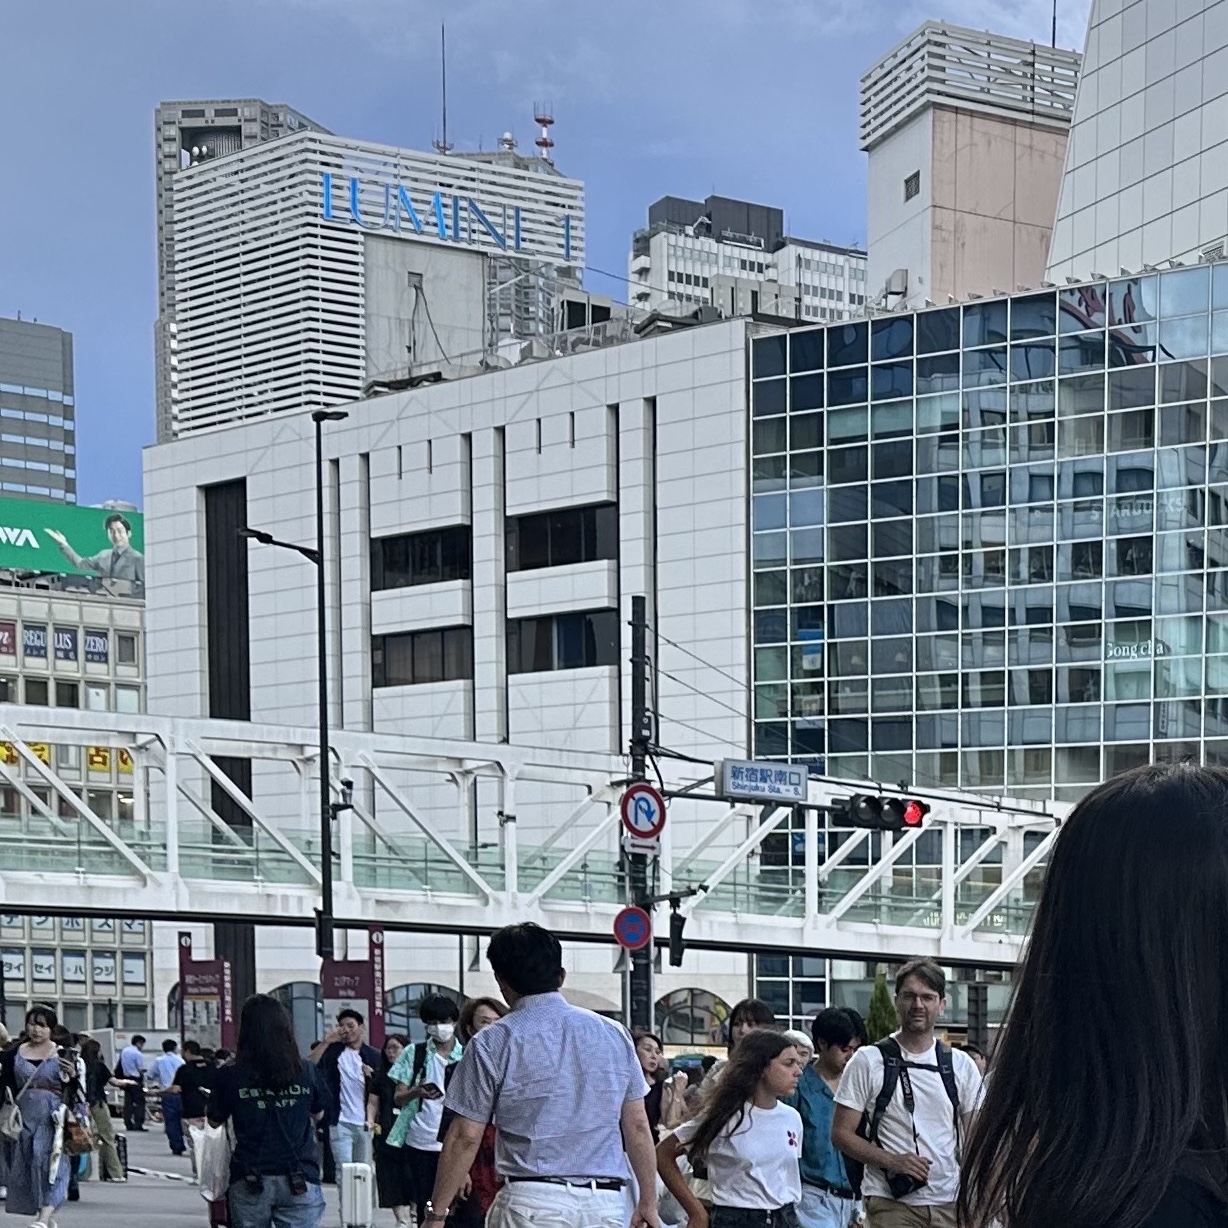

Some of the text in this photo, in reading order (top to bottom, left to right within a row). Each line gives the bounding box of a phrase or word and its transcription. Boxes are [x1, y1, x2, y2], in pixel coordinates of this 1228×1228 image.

[730, 764, 801, 786] 新宿駅南口
